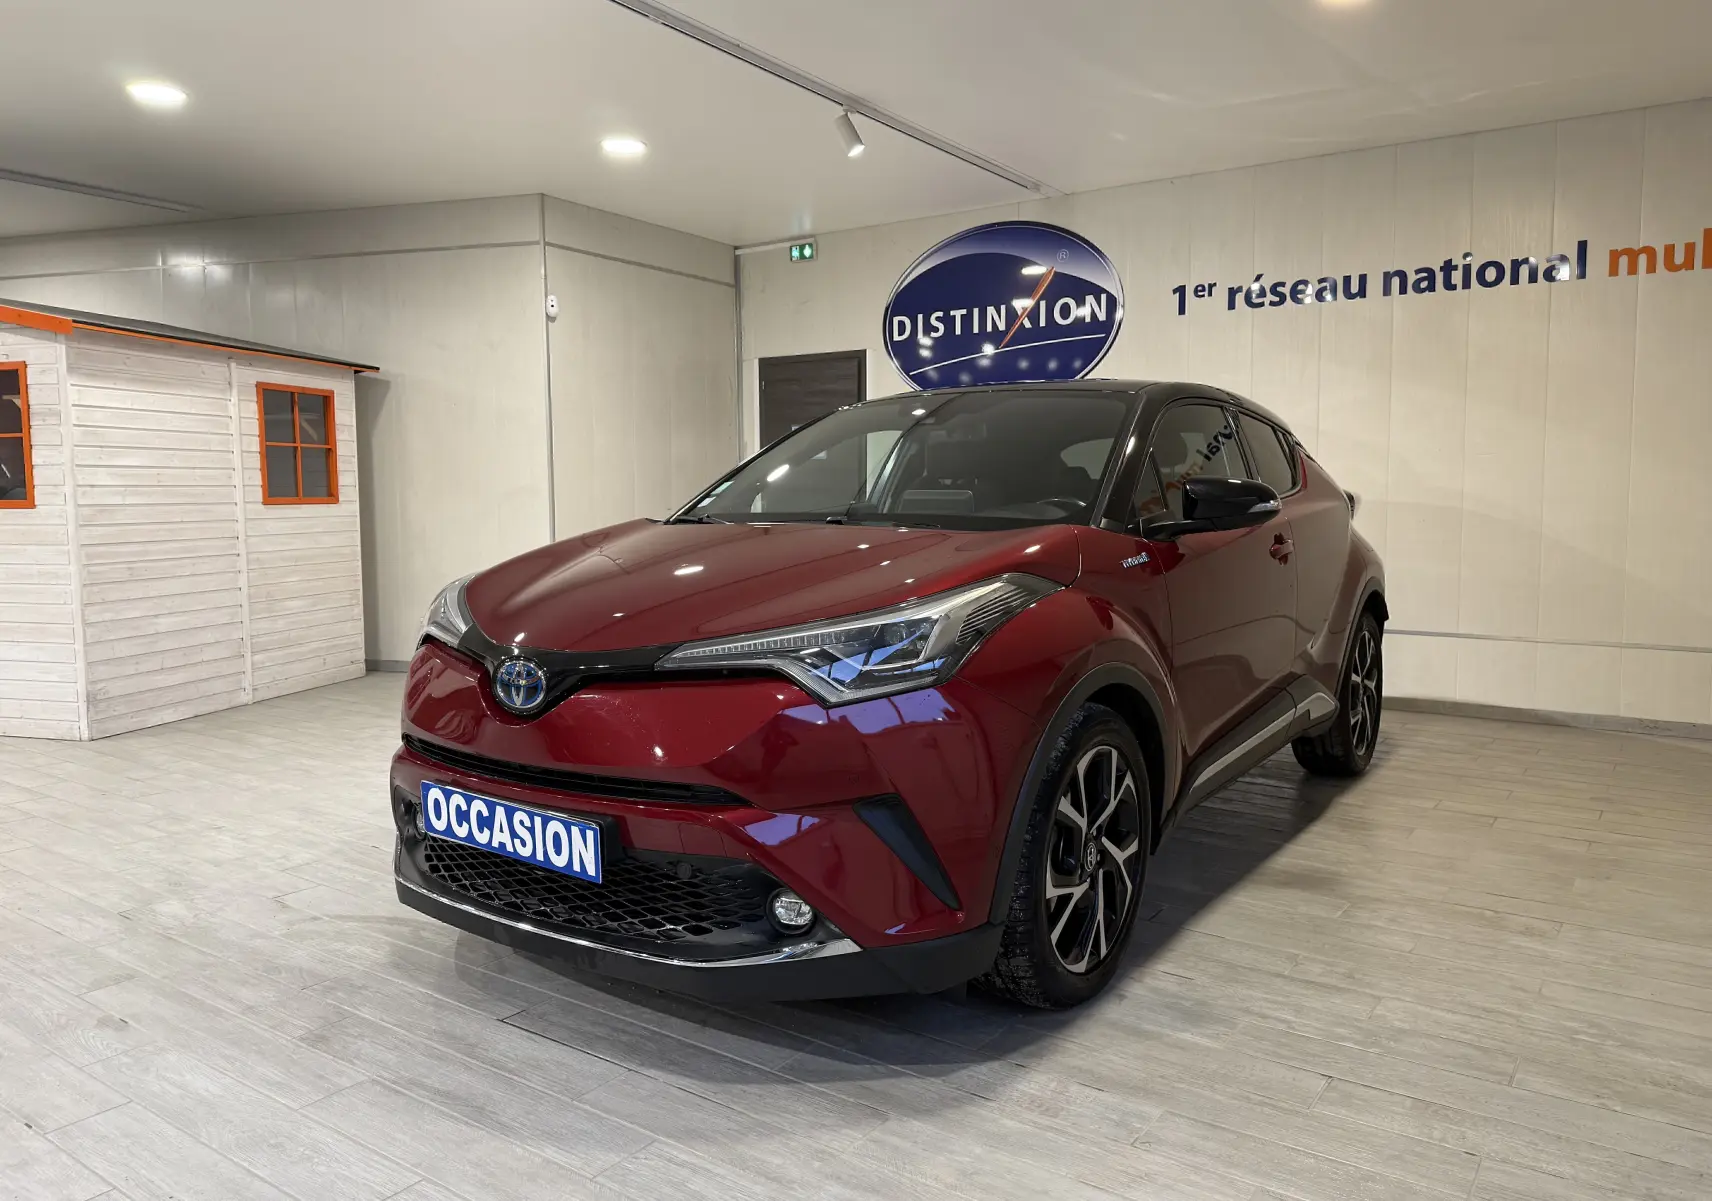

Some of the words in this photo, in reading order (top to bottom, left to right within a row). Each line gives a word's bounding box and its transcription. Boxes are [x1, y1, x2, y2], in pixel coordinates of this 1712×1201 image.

[1226, 273, 1368, 311] réseau
[1382, 240, 1588, 297] national
[1607, 227, 1712, 278] mul
[891, 293, 1108, 342] DISTINXION
[426, 786, 597, 878] OCCASION
